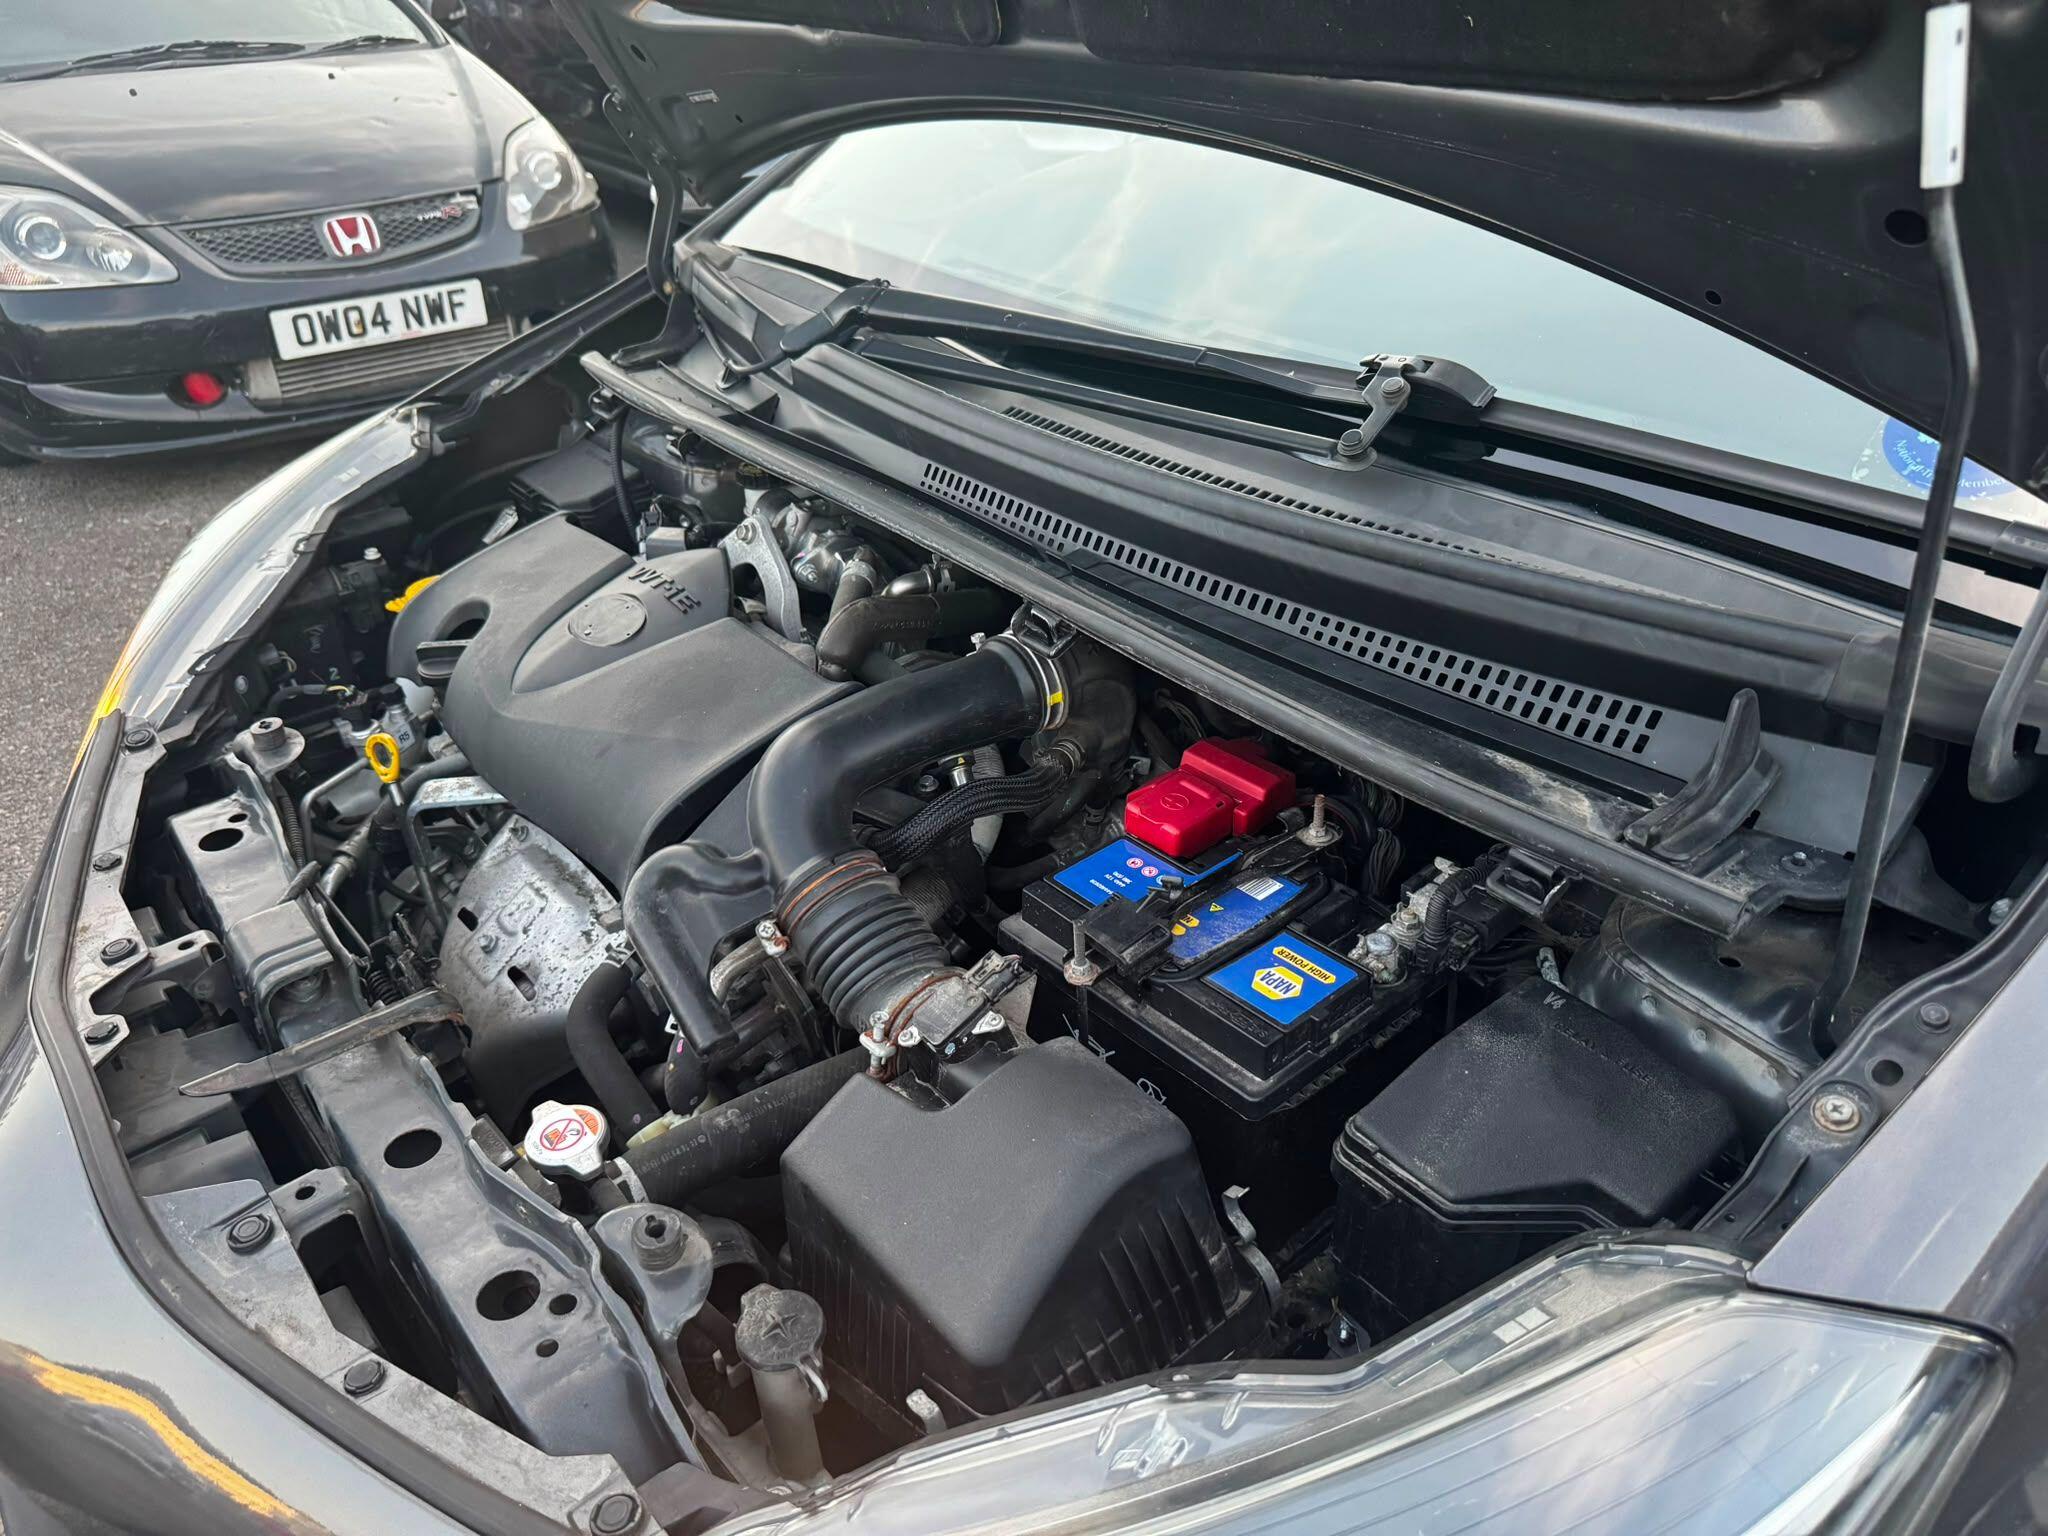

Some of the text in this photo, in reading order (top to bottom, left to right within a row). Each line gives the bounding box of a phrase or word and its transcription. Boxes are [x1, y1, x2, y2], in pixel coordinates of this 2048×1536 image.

[291, 288, 466, 347] OW04 NWF
[1277, 948, 1332, 981] HIGH POWER
[1260, 970, 1297, 995] NAPA
